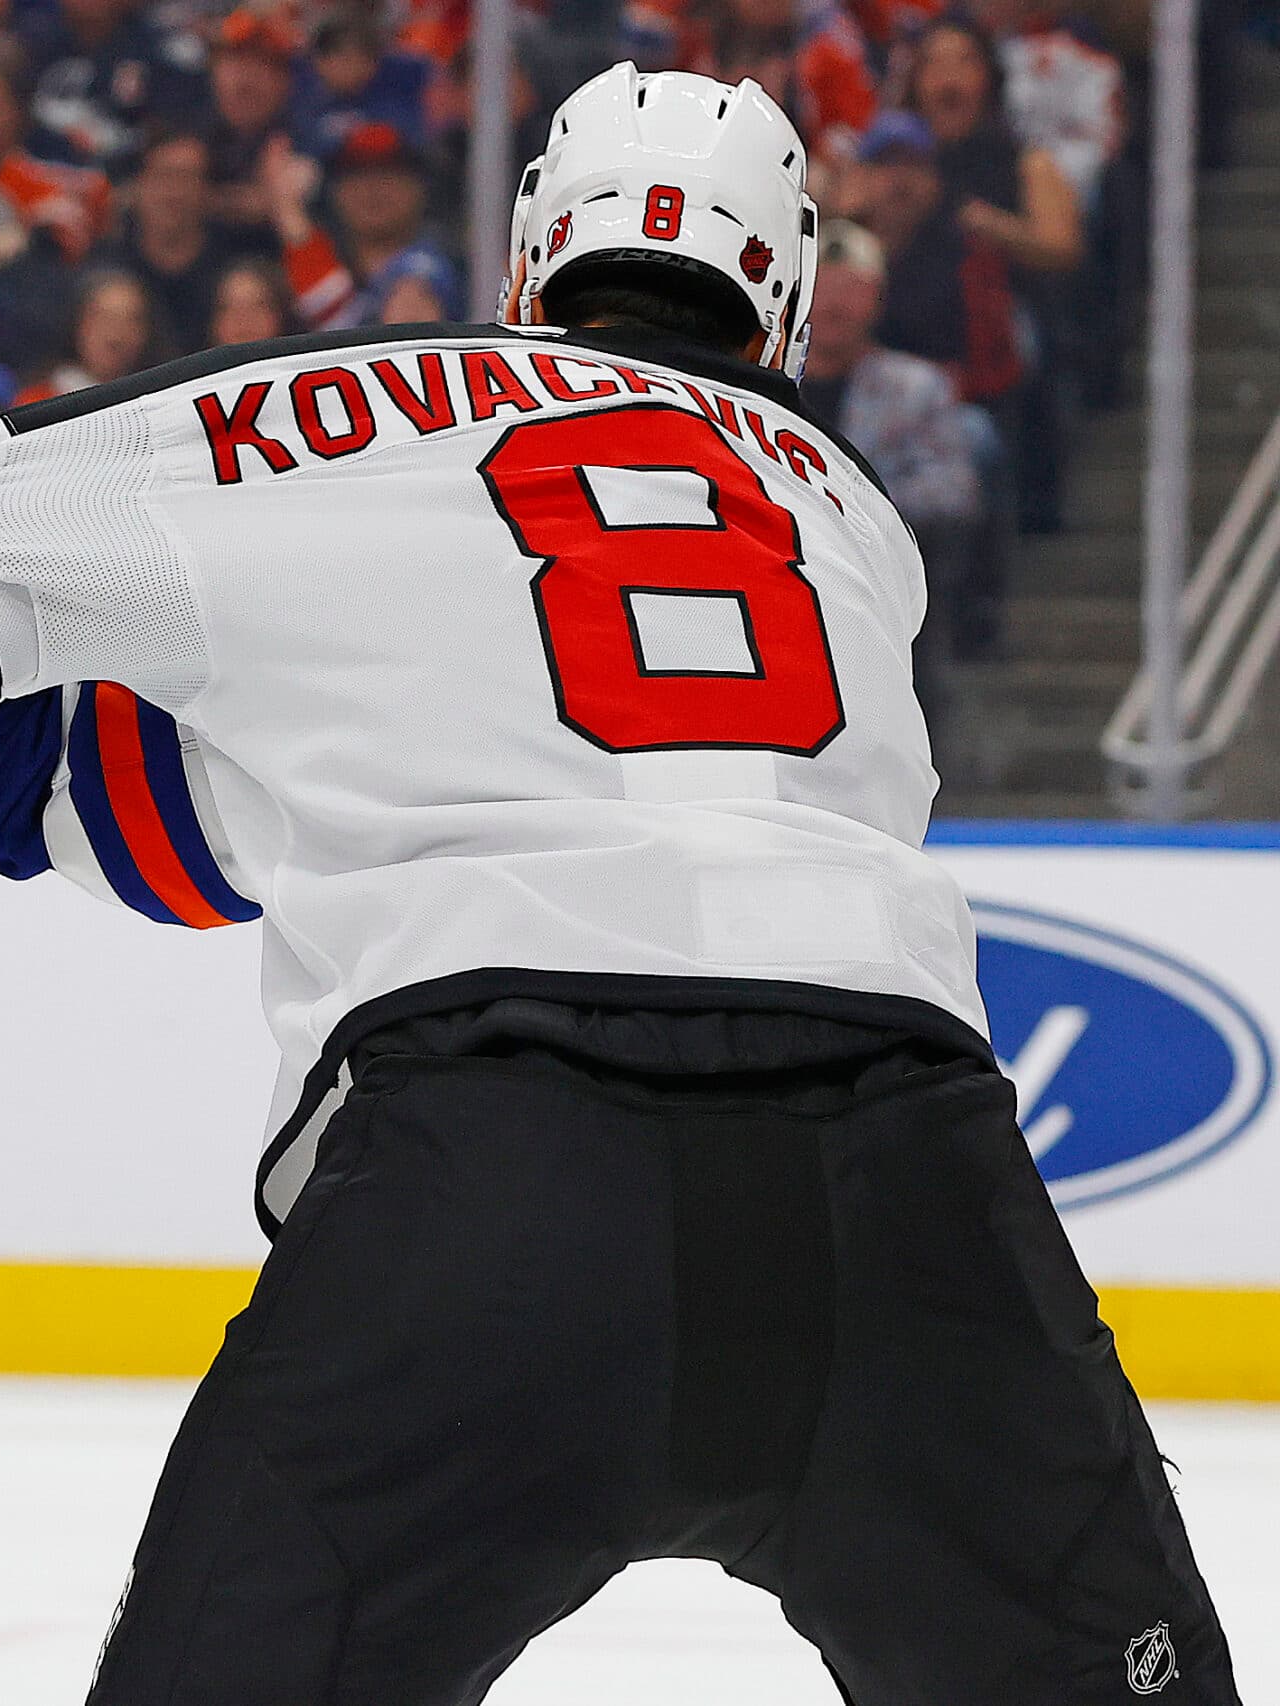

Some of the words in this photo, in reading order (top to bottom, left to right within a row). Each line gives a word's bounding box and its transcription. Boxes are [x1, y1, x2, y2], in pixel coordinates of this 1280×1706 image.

[642, 184, 685, 242] 8
[476, 402, 847, 758] 8
[1139, 1638, 1163, 1685] NHL
